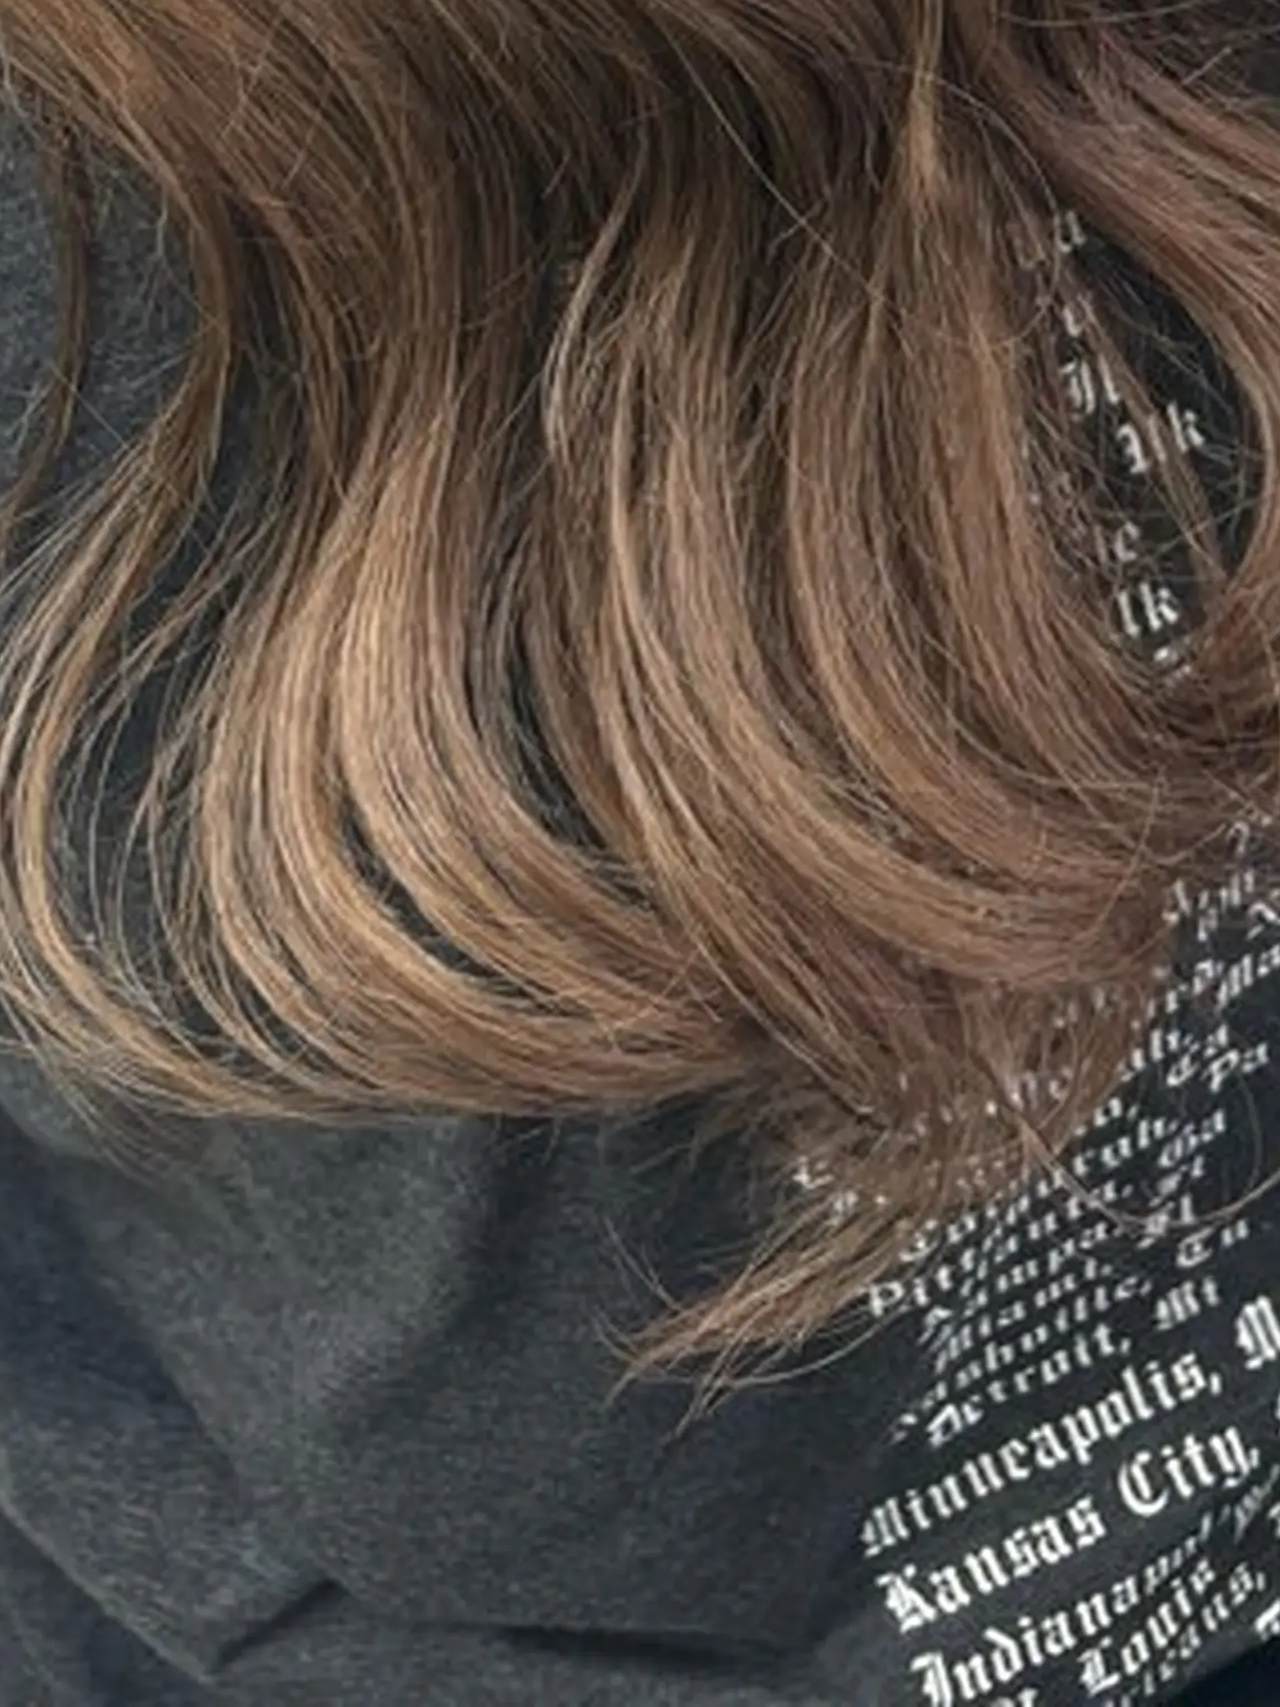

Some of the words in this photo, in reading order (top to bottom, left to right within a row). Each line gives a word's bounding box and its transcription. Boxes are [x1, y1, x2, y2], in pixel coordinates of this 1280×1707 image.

[859, 1353, 1222, 1559] Minneapolis,
[875, 1495, 1107, 1635] Kansas
[1117, 1425, 1260, 1517] City,
